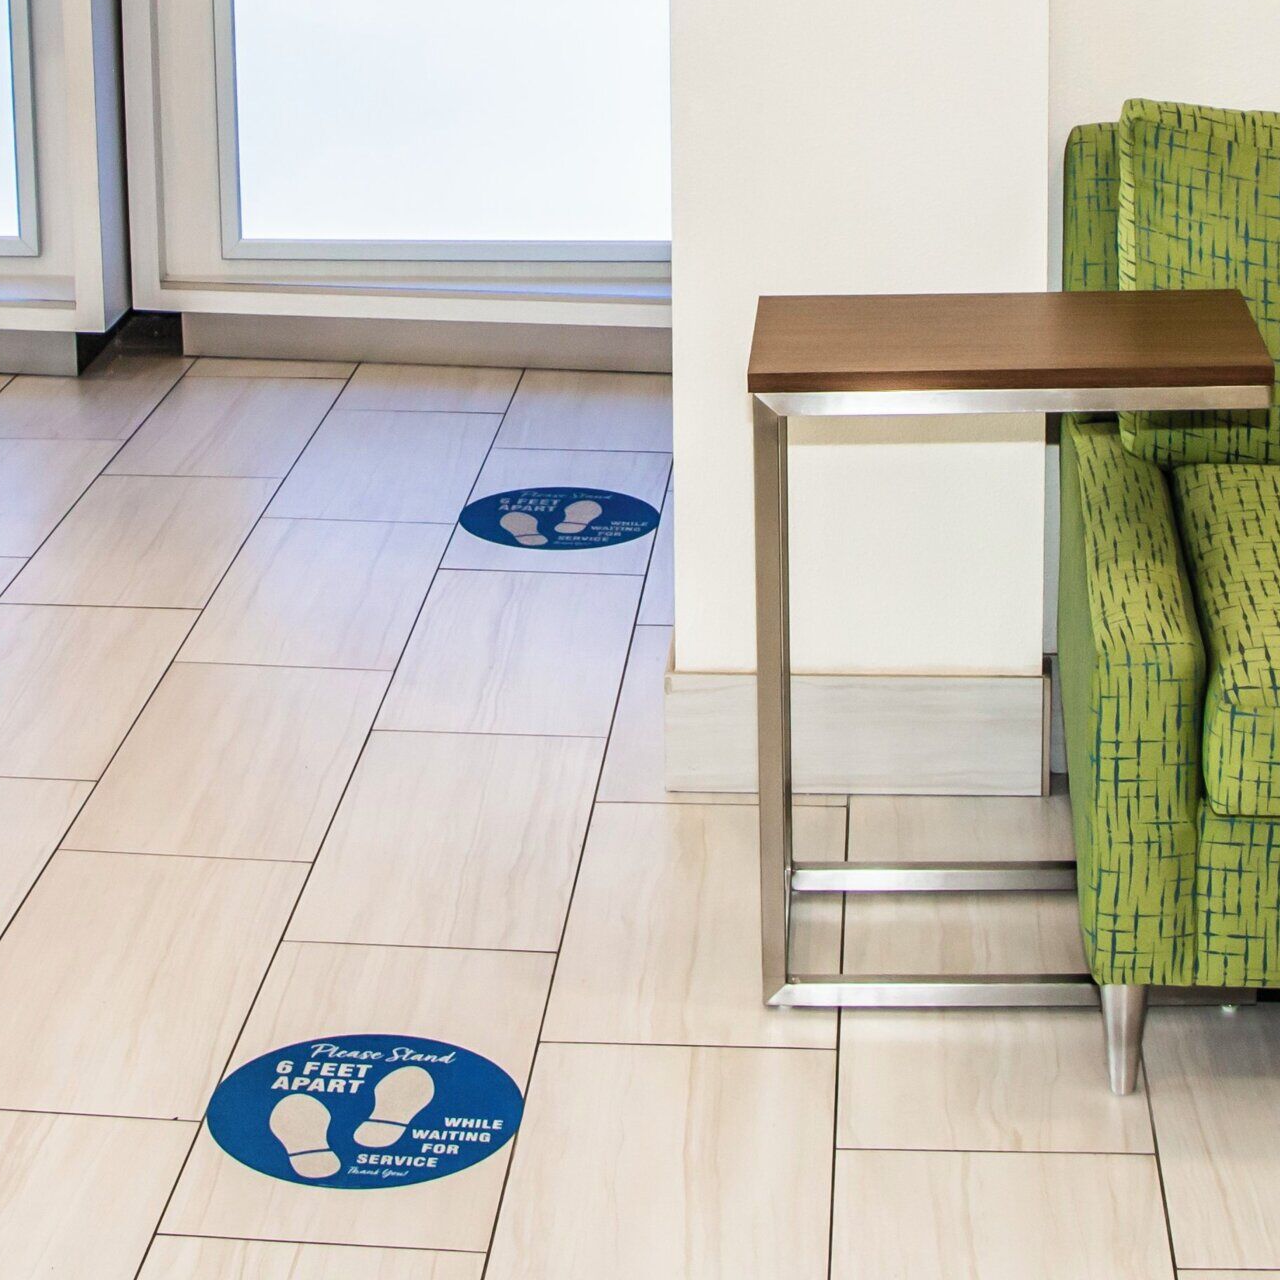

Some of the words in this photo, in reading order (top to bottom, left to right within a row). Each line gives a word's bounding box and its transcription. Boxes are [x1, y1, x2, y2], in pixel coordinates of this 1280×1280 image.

[498, 504, 557, 513] APART
[516, 498, 561, 506] FEET
[310, 1043, 385, 1061] Please
[384, 1046, 457, 1065] Stand
[275, 1060, 294, 1075] 6
[302, 1061, 373, 1079] FEET
[270, 1076, 365, 1094] APART
[443, 1116, 504, 1130] WHILE
[411, 1129, 492, 1143] WAITING
[421, 1142, 460, 1155] FOR
[356, 1153, 439, 1168] SERVICE
[347, 1166, 380, 1175] Thank
